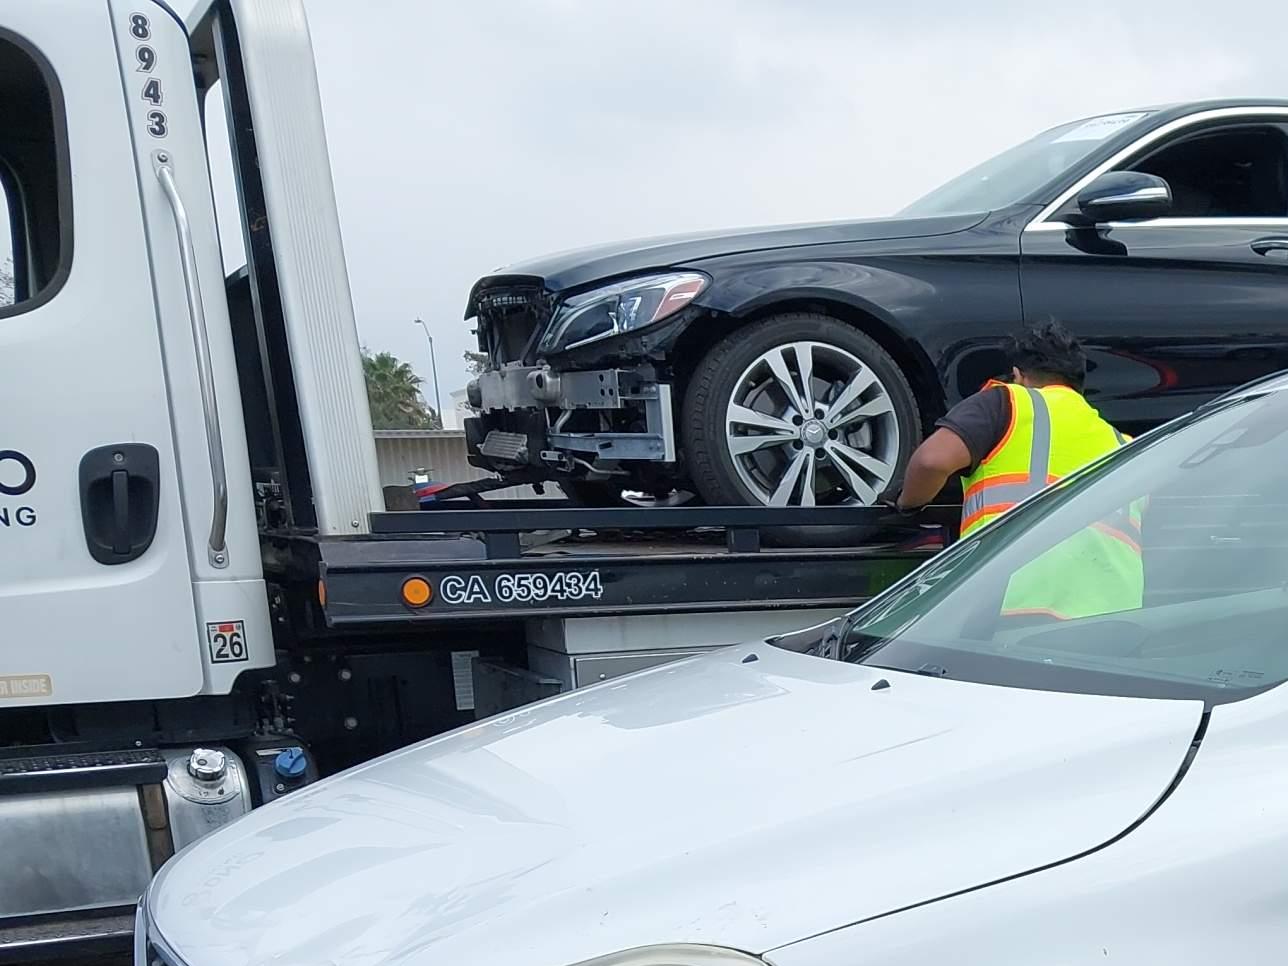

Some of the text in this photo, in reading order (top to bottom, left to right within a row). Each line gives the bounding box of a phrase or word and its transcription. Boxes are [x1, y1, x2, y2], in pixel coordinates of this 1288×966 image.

[129, 11, 169, 138] 8943
[440, 569, 603, 604] CA 659434
[213, 632, 243, 659] 26
